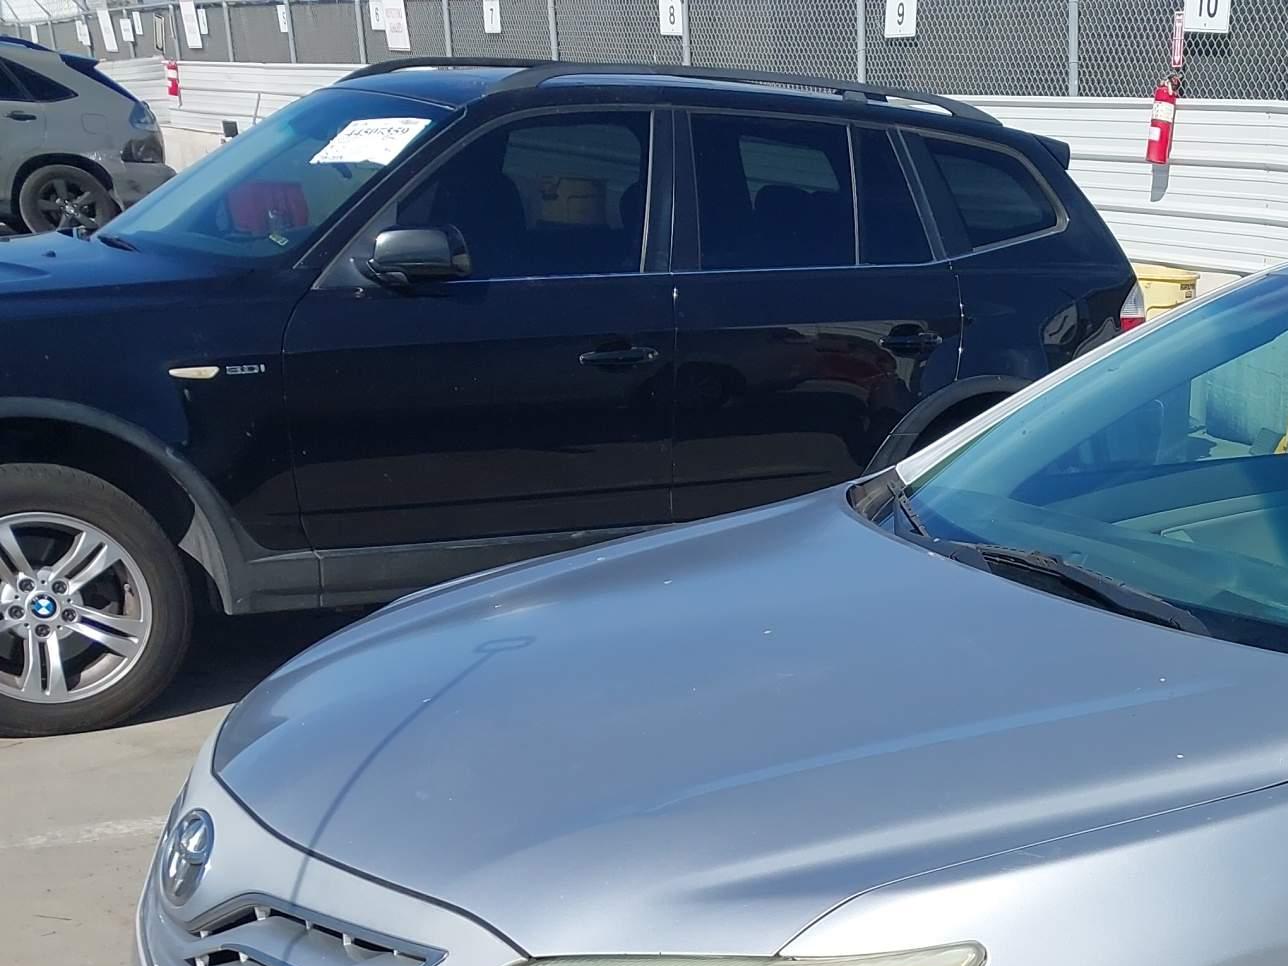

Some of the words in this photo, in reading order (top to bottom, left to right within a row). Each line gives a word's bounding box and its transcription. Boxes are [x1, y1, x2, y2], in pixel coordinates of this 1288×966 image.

[374, 7, 380, 22] 6
[668, 5, 675, 25] 8
[897, 2, 905, 26] 9
[1198, 0, 1218, 18] 10
